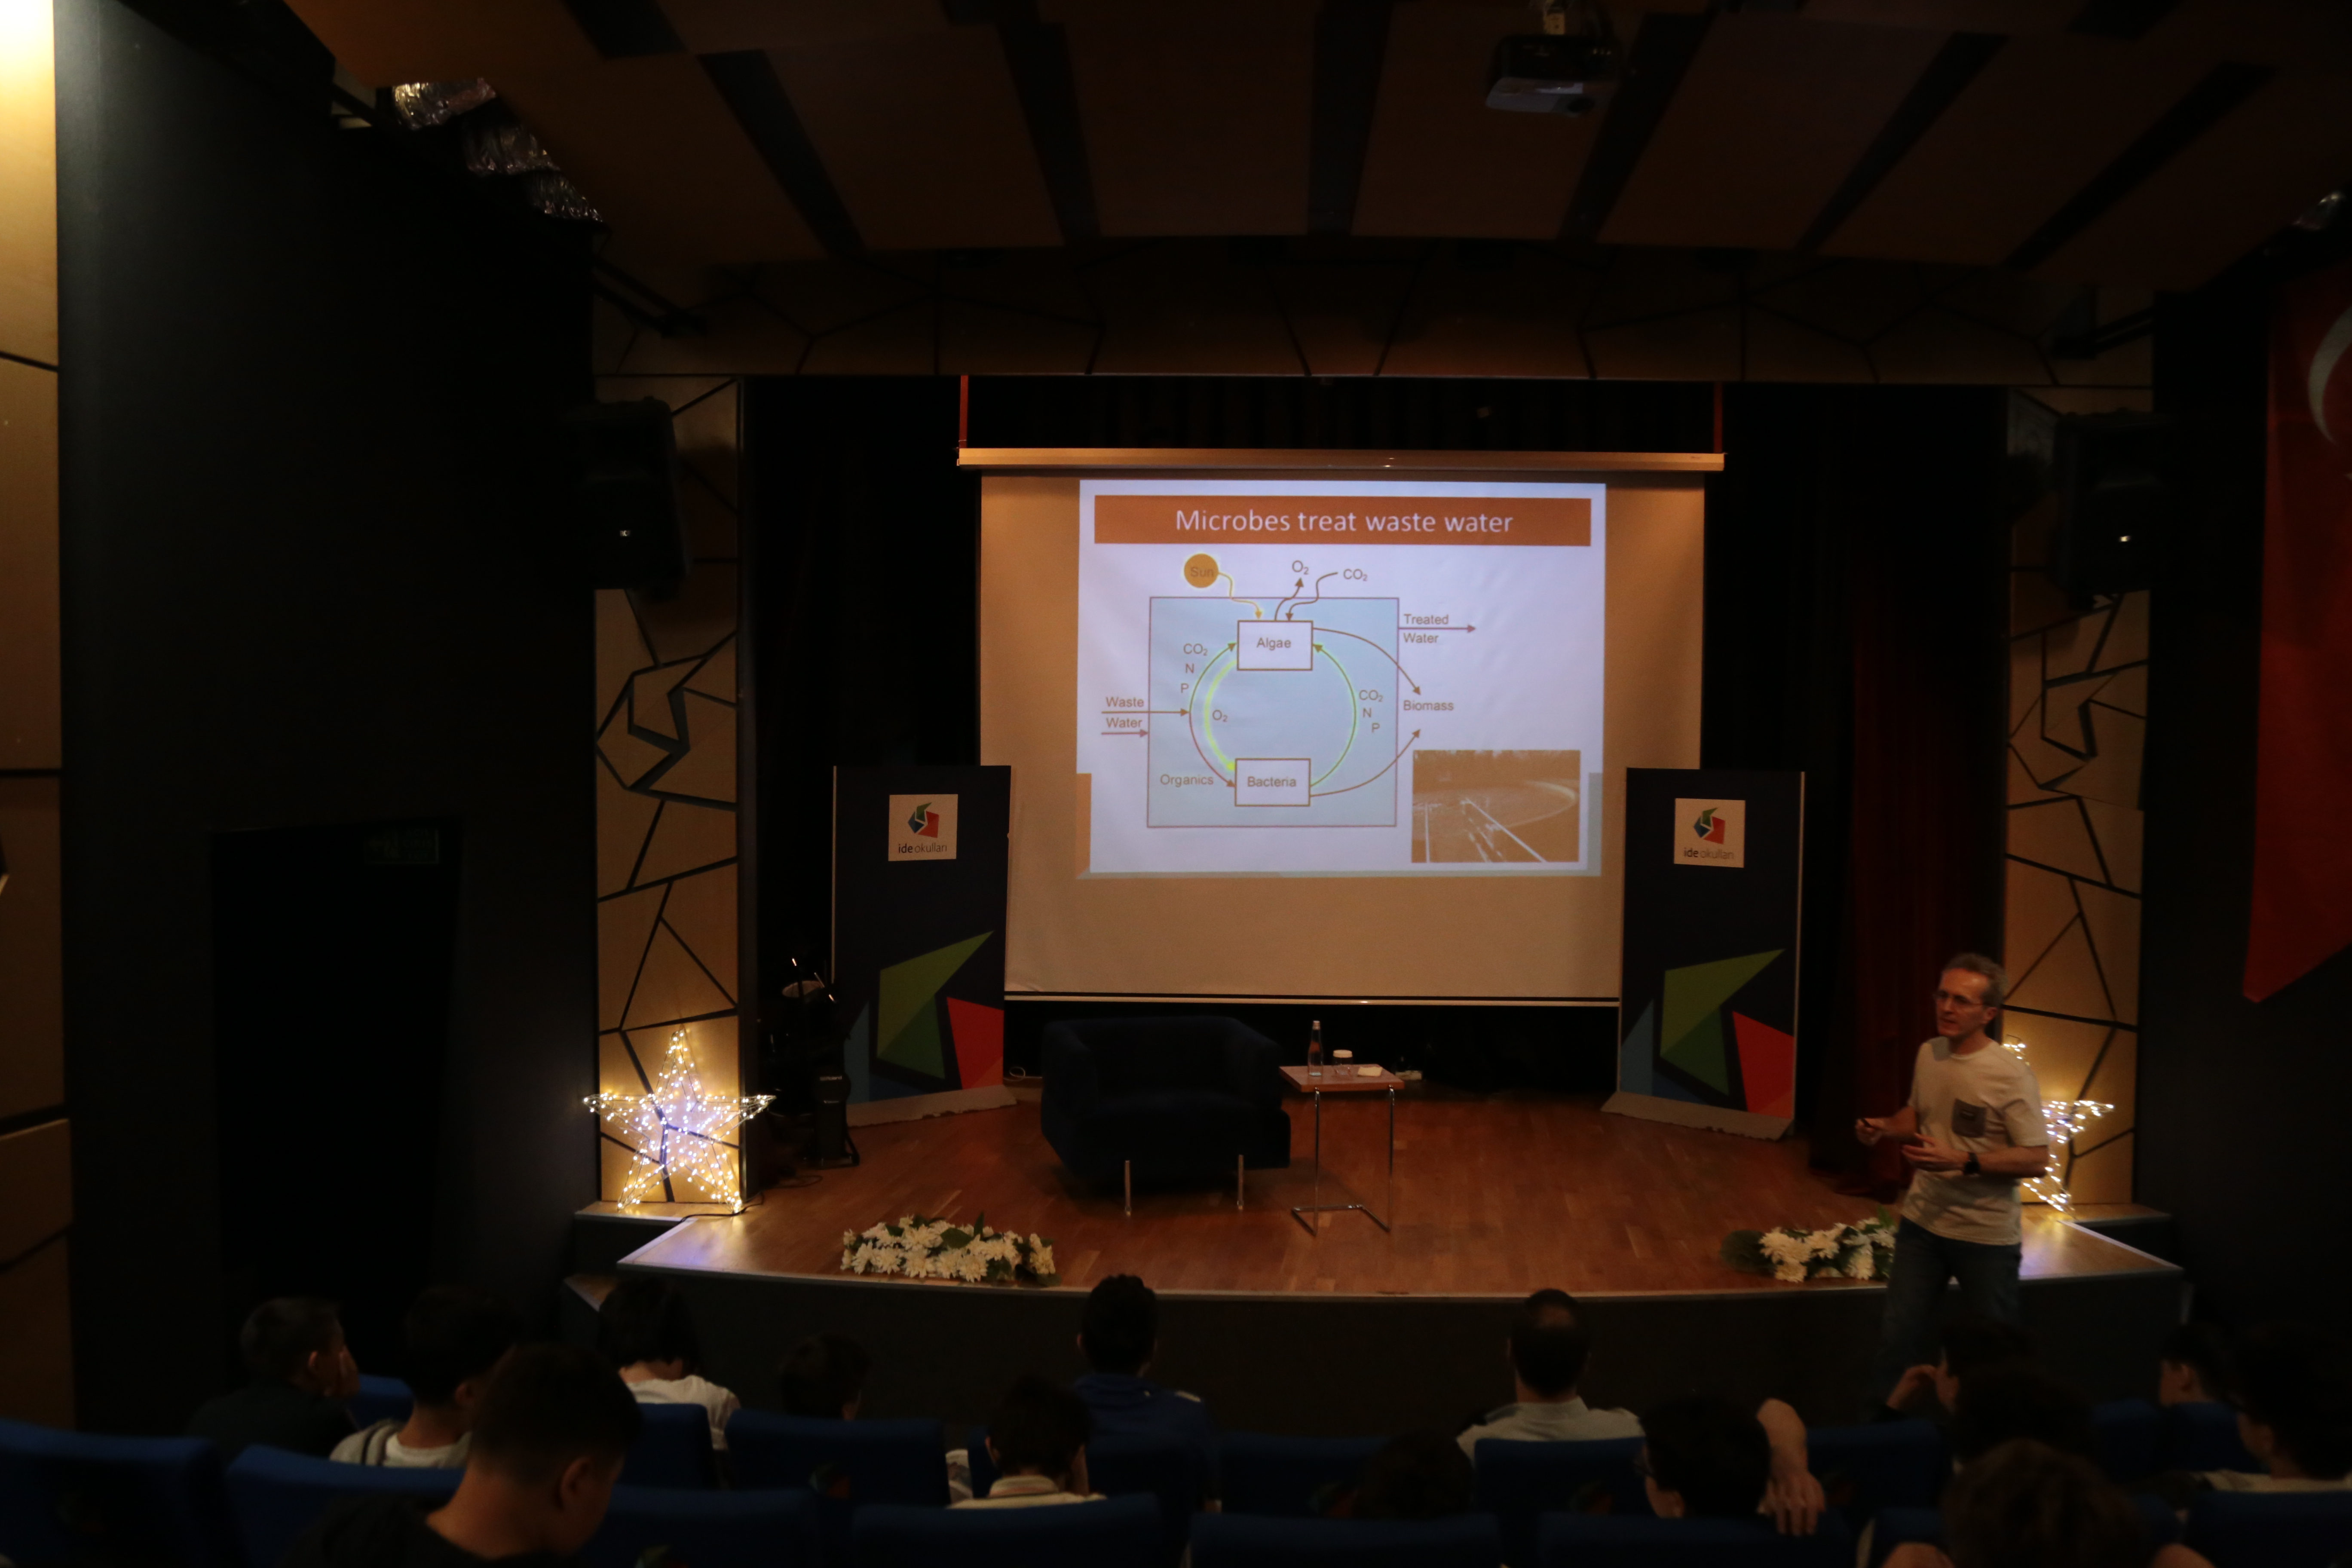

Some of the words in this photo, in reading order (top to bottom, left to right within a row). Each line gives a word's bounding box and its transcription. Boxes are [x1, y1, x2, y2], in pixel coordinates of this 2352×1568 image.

[1176, 509, 1290, 531] Microbes
[1298, 512, 1357, 532] treat
[1365, 513, 1436, 532] waste
[1444, 514, 1513, 533] water
[1190, 566, 1215, 578] Sun
[1403, 613, 1449, 625] Treated
[1256, 637, 1292, 650] Algae
[1403, 633, 1439, 643] Water
[1185, 663, 1194, 674] N
[1180, 683, 1189, 693] P
[1106, 696, 1144, 707] Waste
[1403, 700, 1454, 711] Biomass
[1363, 707, 1372, 718] N
[1106, 717, 1143, 728] Water
[1371, 723, 1380, 732] P
[1160, 774, 1214, 787] Organics
[1247, 776, 1297, 787] Bacteria
[898, 843, 913, 853] ide
[1684, 847, 1698, 858] ide
